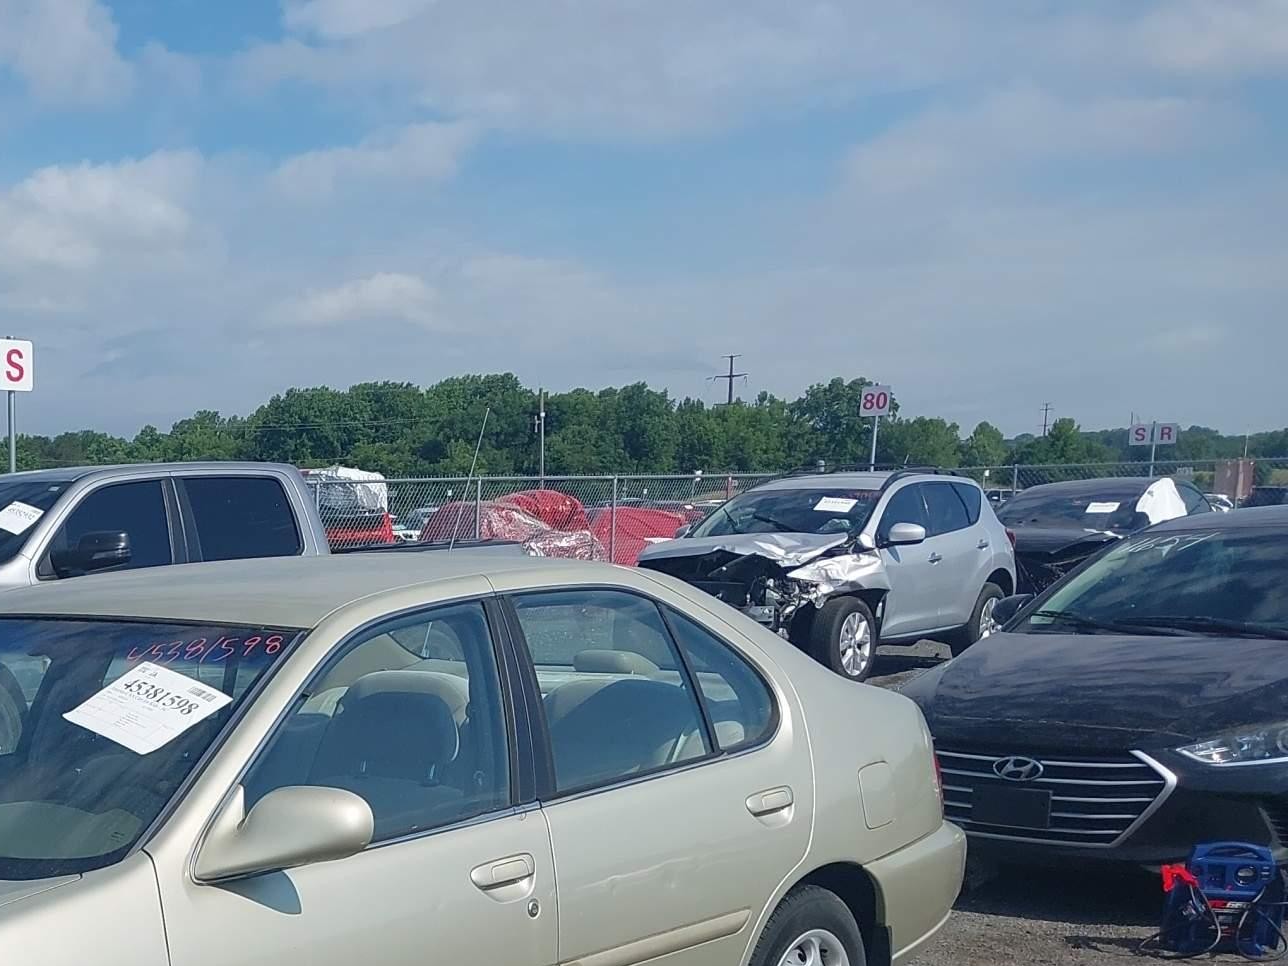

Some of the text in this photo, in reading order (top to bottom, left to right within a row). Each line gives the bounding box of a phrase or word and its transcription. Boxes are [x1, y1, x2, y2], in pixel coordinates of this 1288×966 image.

[5, 348, 25, 383] S
[862, 391, 888, 411] 80
[1134, 427, 1147, 442] S
[1160, 426, 1173, 441] R
[126, 634, 284, 664] 45381598
[123, 678, 200, 716] 45381598
